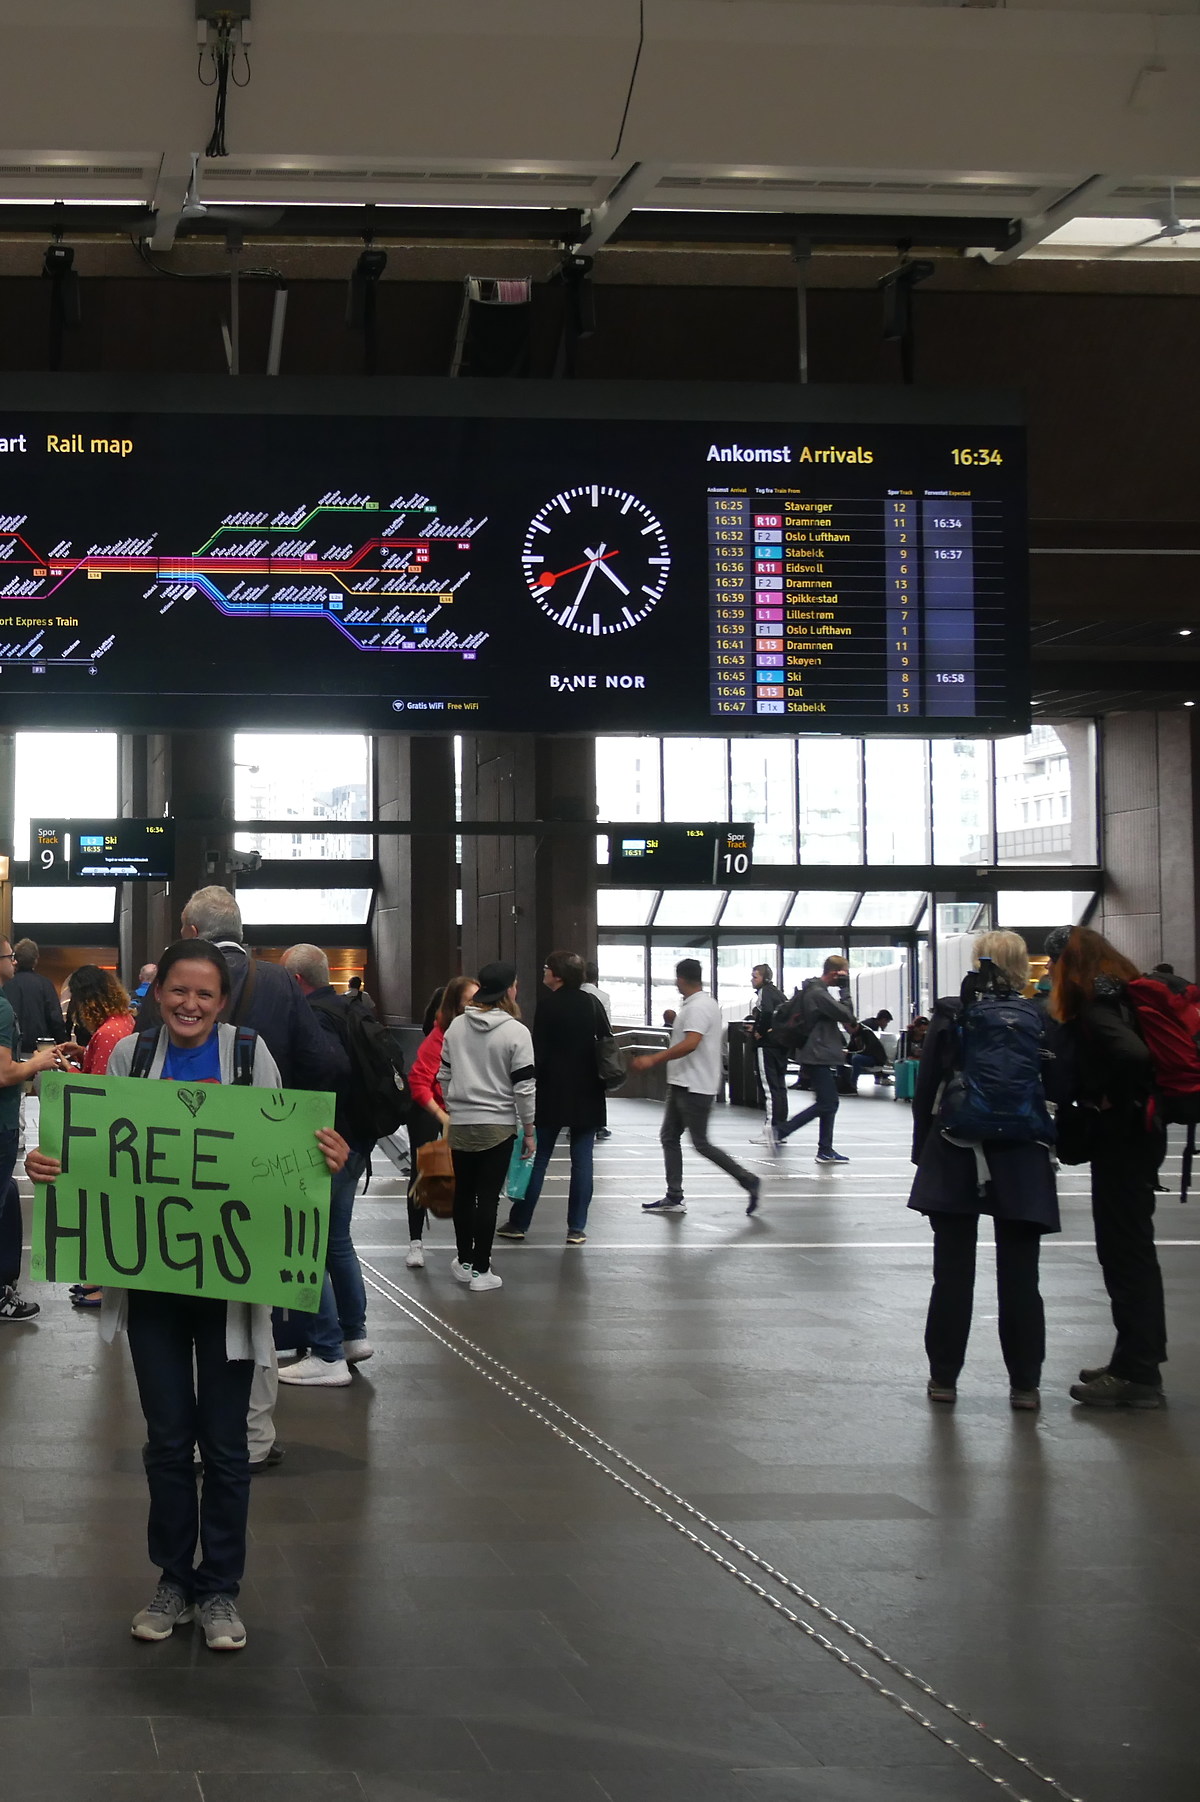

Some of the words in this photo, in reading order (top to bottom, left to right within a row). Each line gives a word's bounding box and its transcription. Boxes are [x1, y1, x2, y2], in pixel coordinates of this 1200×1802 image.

[48, 435, 84, 452] Rail
[91, 440, 132, 457] map
[707, 444, 791, 462] Ankomst
[800, 446, 873, 463] Arrivals
[952, 449, 1002, 465] 16:34
[715, 501, 742, 510] 16:25
[785, 502, 832, 513] Stavanger
[716, 516, 741, 525] 16:31
[786, 517, 831, 526] Drammen
[934, 519, 961, 528] 16:34
[716, 532, 742, 540] 16:32
[786, 532, 806, 541] Oslo
[810, 532, 850, 541] Lufthavn
[716, 548, 743, 556] 16:33
[786, 548, 824, 557] Stabekk
[935, 550, 962, 559] 16:37
[716, 563, 743, 571] 16:36
[786, 563, 823, 572] Eidsvoll
[716, 578, 743, 587] 16:37
[787, 579, 832, 588] Drammen
[717, 594, 744, 602] 16:39
[786, 594, 837, 604] Spikkestad
[717, 610, 744, 618] 16:39
[787, 610, 834, 619] Lillestrøm
[16, 617, 53, 627] Express
[56, 617, 78, 626] Train
[717, 625, 744, 633] 16:39
[787, 626, 807, 634] Oslo
[811, 626, 851, 634] Lufthavn
[717, 640, 743, 649] 16:41
[787, 641, 832, 650] Drammen
[717, 656, 744, 664] 16:43
[787, 656, 821, 666] Skøyen
[606, 676, 645, 688] NOR
[718, 672, 745, 680] 16:45
[787, 672, 801, 681] Ski
[936, 674, 964, 682] 16:58
[718, 687, 745, 696] 16:46
[787, 688, 803, 697] Dal
[717, 702, 746, 711] 16:47
[788, 703, 826, 711] Stabekk
[38, 829, 55, 837] Spor
[727, 833, 744, 842] Spor
[105, 836, 117, 844] Ski
[727, 840, 746, 848] Track
[41, 850, 54, 869] 9
[724, 854, 748, 873] 10
[61, 1084, 235, 1190] FREE
[45, 1185, 252, 1290] HUGS
